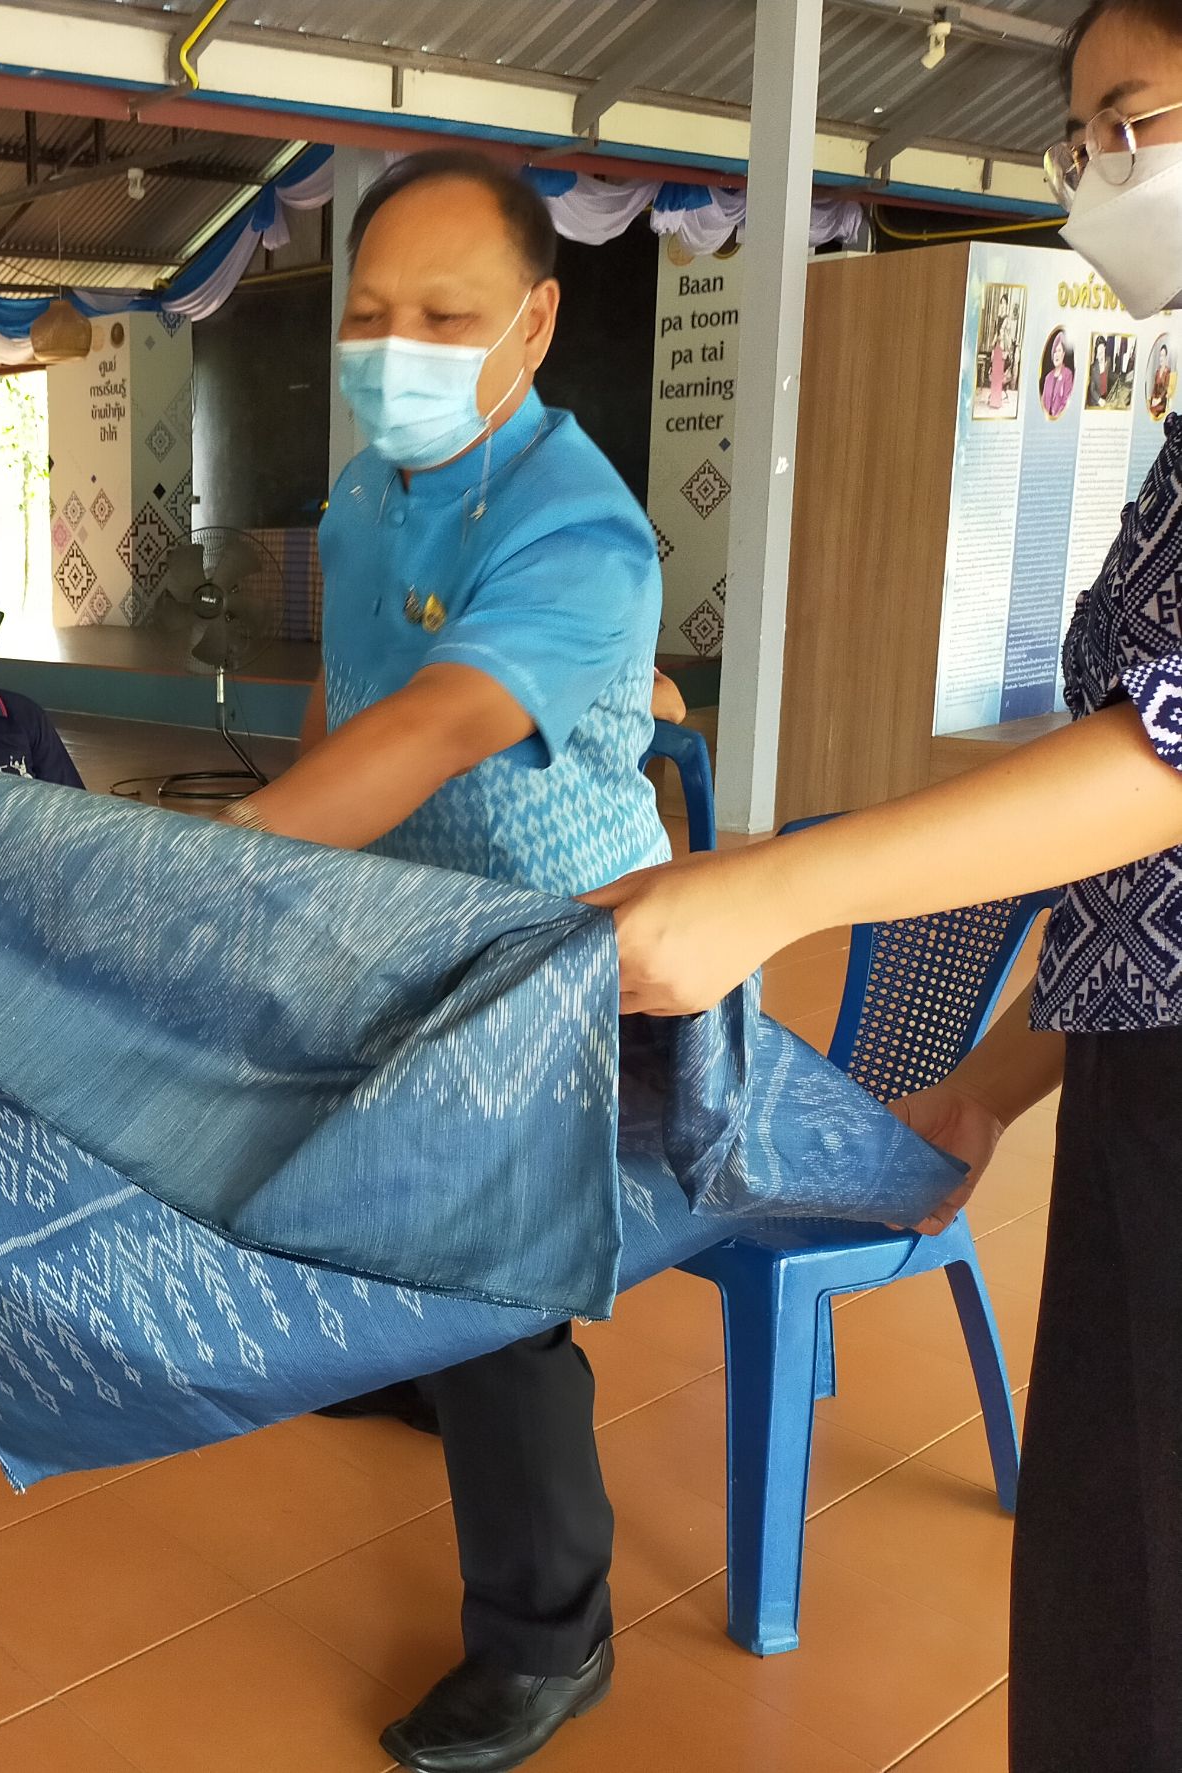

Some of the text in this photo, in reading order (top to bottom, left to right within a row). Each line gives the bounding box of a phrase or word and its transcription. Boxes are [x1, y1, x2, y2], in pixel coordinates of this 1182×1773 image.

[678, 275, 724, 296] Baan
[661, 309, 739, 338] pa toom
[671, 341, 724, 370] pa tai
[659, 377, 735, 400] learning
[666, 412, 724, 432] center
